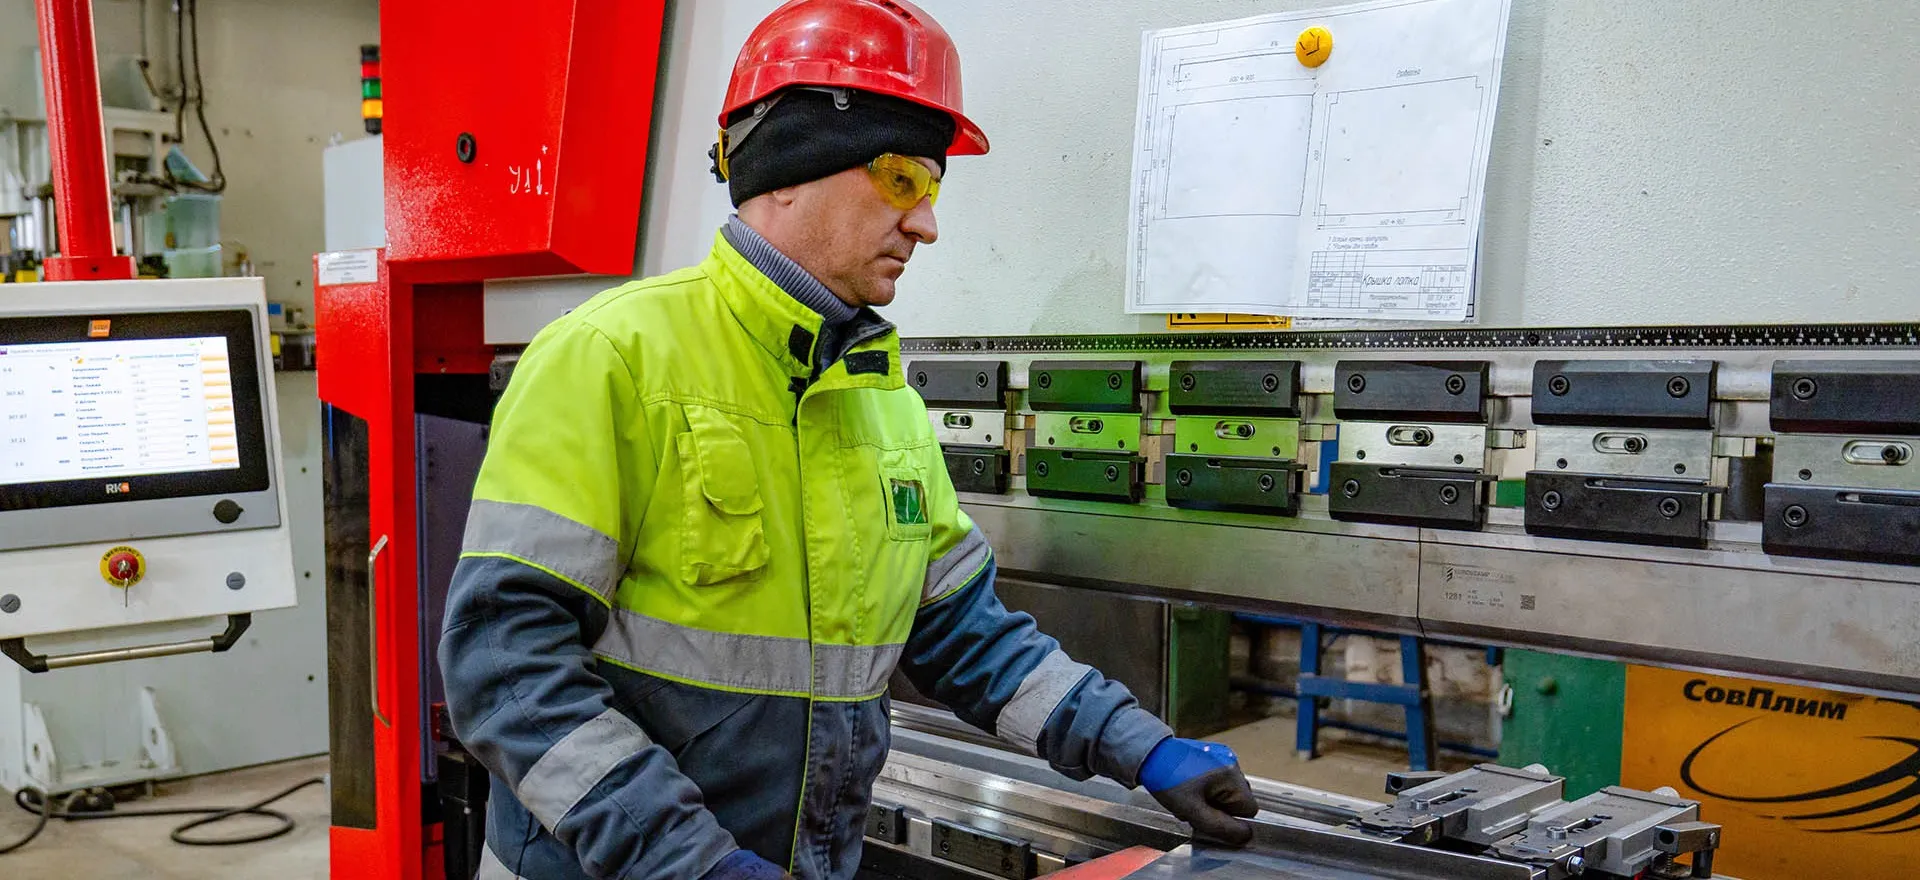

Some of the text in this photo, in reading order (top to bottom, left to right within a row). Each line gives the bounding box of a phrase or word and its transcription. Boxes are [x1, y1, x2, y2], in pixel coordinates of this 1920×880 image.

[1362, 274, 1420, 288] Крышка лотка
[1683, 679, 1848, 720] СовПлим
